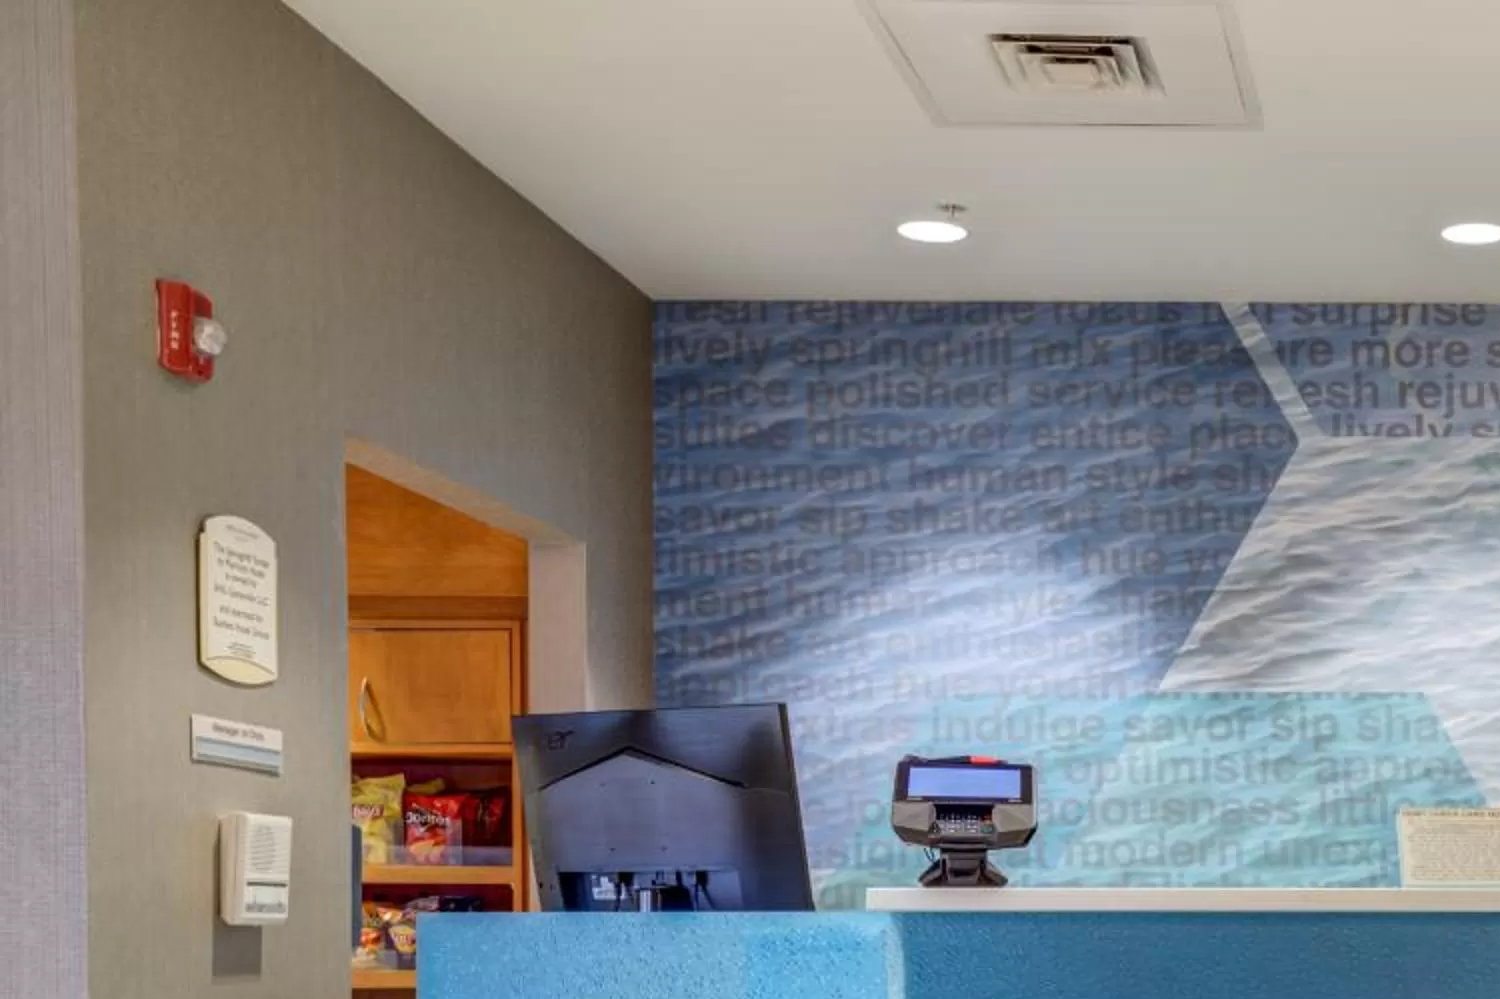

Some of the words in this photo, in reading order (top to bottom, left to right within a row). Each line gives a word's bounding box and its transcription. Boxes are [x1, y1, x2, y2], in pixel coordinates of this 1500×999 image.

[1291, 302, 1485, 335] surprise
[787, 329, 1013, 377] springhill
[1032, 332, 1111, 367] mix
[1351, 338, 1470, 368] more
[655, 379, 791, 416] space
[806, 372, 1009, 418] polished
[1028, 373, 1198, 408] service
[1214, 374, 1379, 409] reesh
[808, 415, 1009, 450] discover
[1028, 415, 1161, 450] entice
[1190, 413, 1297, 461] plac
[908, 459, 1069, 491] human
[1086, 459, 1197, 502] style
[797, 499, 871, 546] sip
[886, 499, 1025, 534] shake
[1041, 500, 1104, 534] art
[1082, 541, 1168, 576] hue
[931, 707, 1106, 753] indulge
[1124, 712, 1256, 743] savor
[1270, 706, 1341, 752] sip
[1063, 747, 1299, 795] optimistic
[1064, 831, 1244, 868] modern
